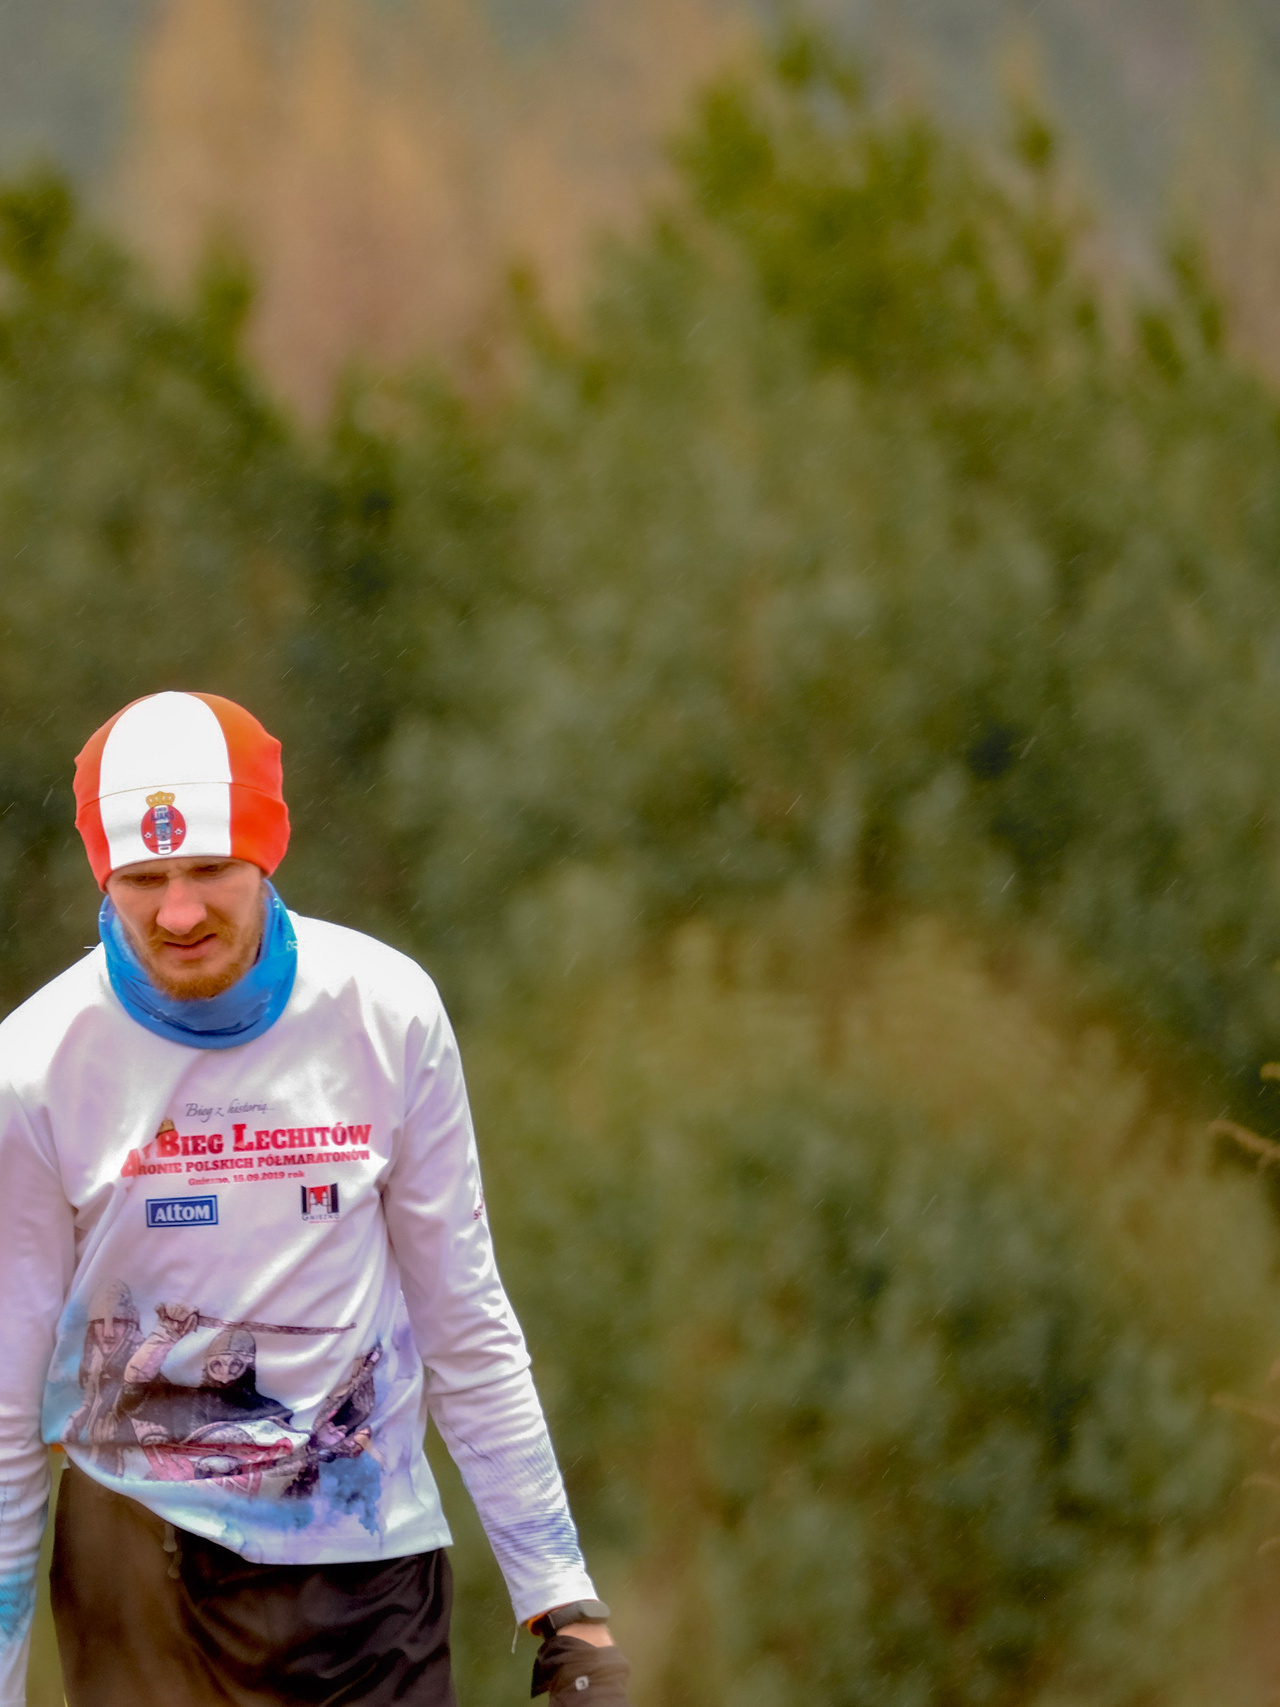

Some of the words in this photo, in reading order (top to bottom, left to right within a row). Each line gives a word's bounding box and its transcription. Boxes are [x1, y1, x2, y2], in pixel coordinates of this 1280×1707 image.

[185, 1102, 213, 1123] Bieg
[215, 1107, 224, 1117] z
[156, 1129, 224, 1158] BIEG
[232, 1122, 372, 1152] LECHITÓW
[186, 1157, 254, 1173] POLSKICH
[257, 1149, 370, 1168] PÓŁMARATONÓW
[288, 1170, 305, 1179] rok
